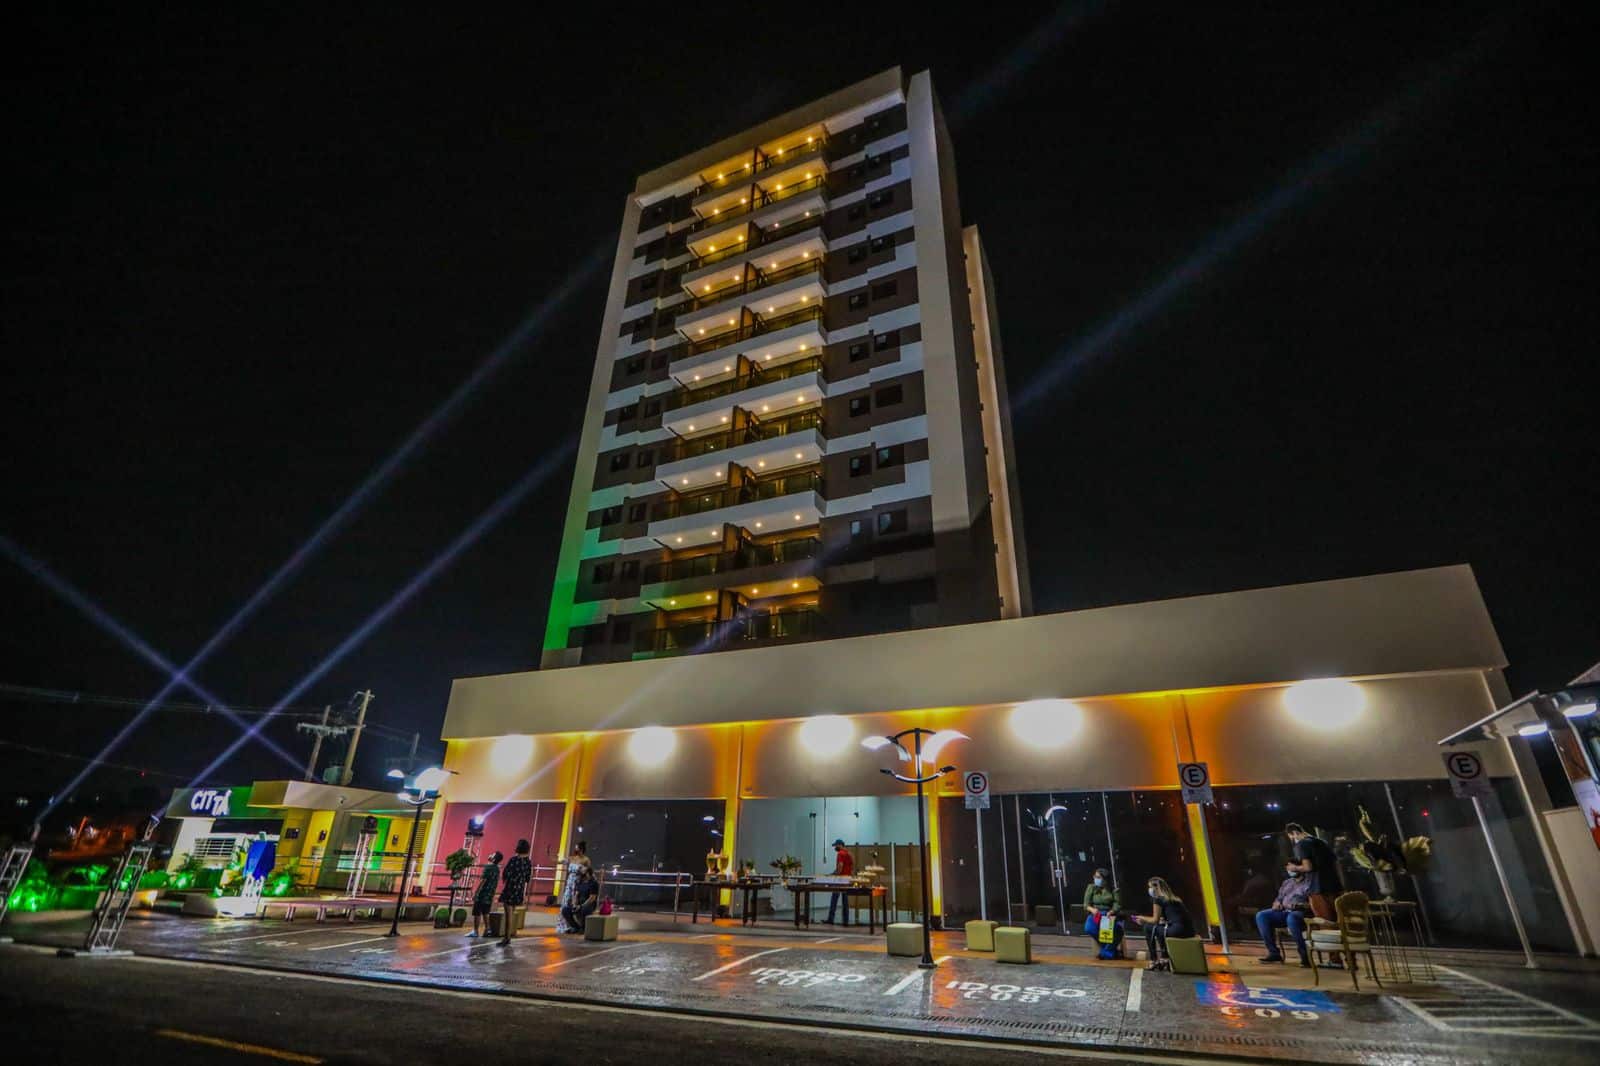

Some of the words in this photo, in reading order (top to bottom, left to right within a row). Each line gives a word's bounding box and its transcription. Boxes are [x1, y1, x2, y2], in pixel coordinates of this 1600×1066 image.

[1455, 757, 1473, 774] E
[972, 776, 981, 790] E
[1188, 768, 1202, 783] E
[945, 980, 1086, 998] IDOSO
[1220, 1006, 1319, 1020] C09
